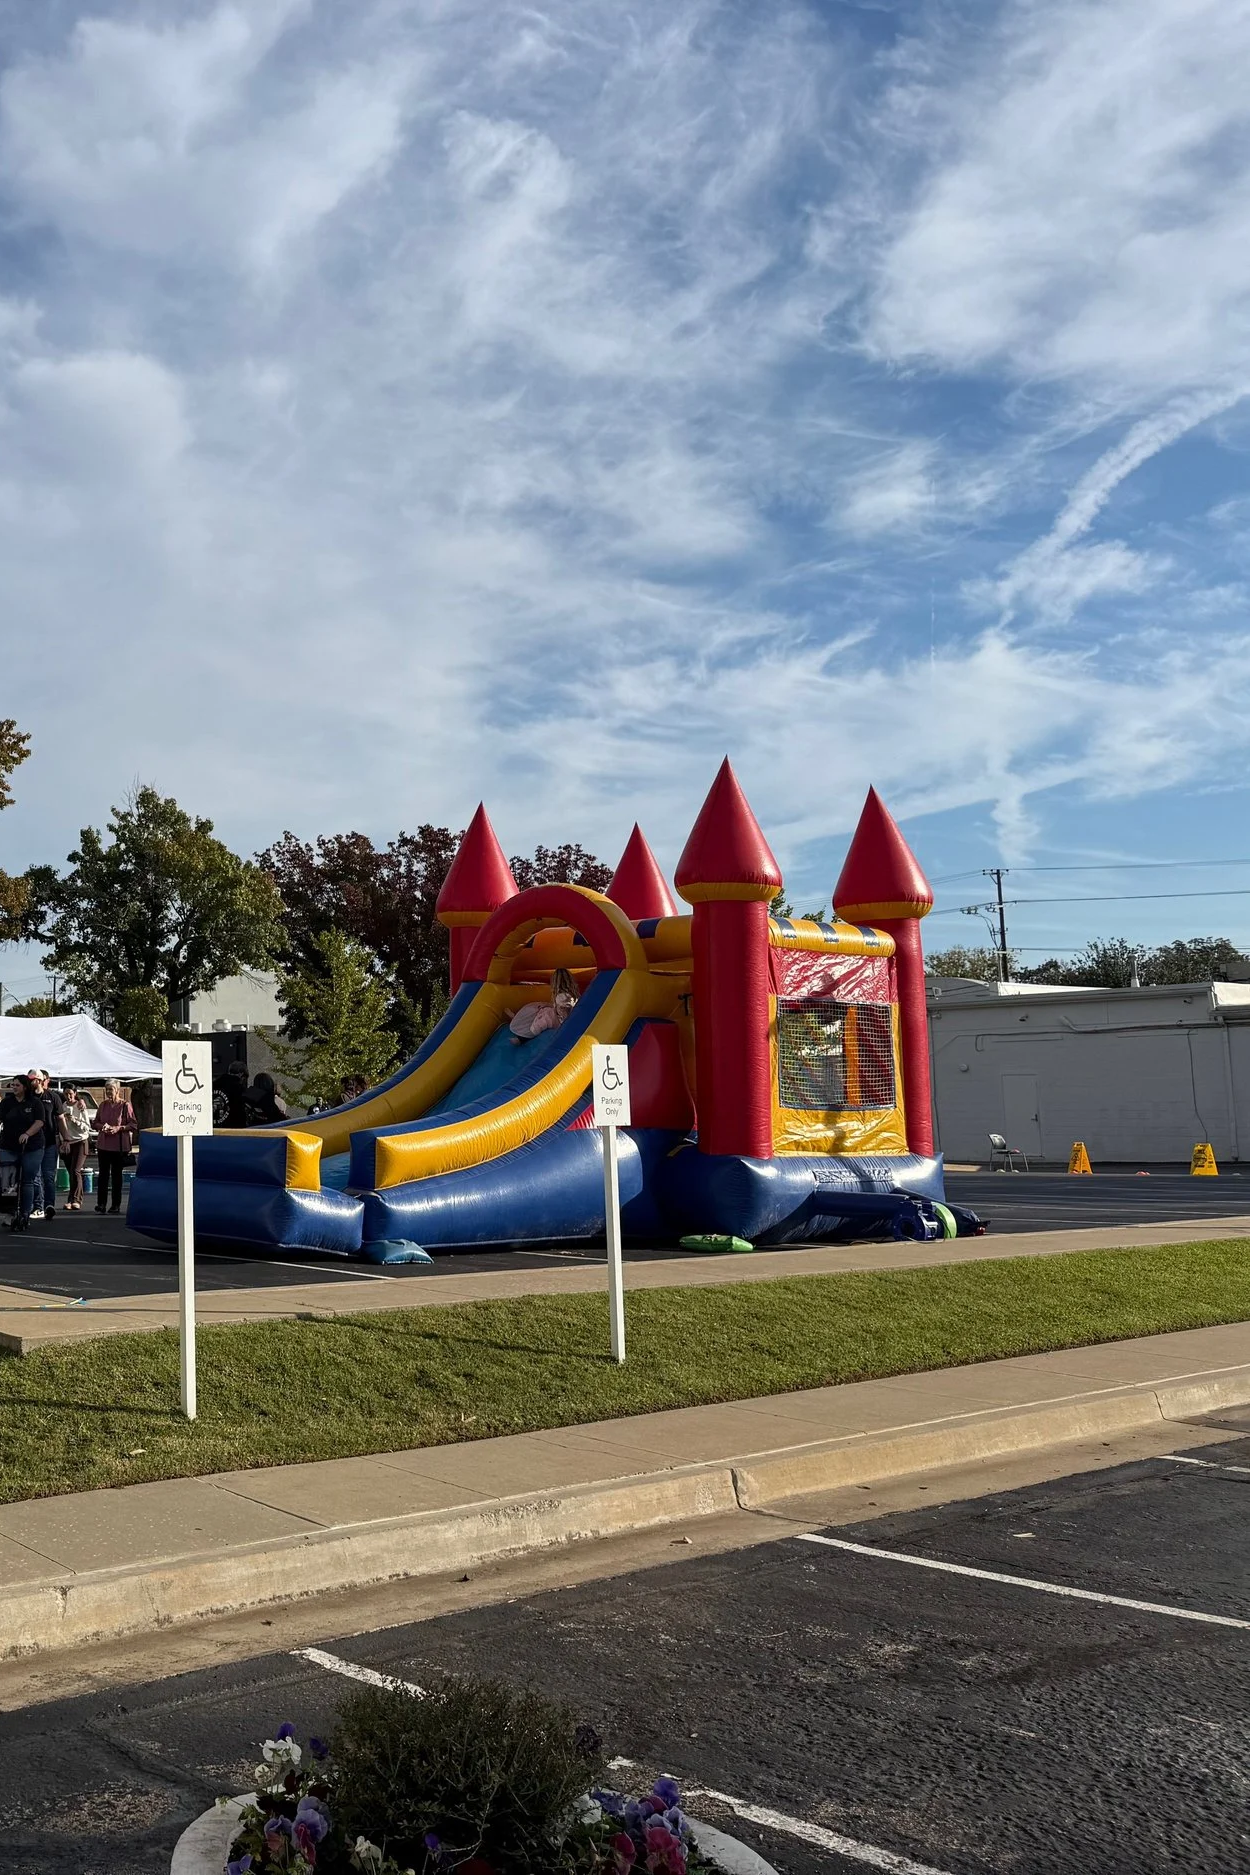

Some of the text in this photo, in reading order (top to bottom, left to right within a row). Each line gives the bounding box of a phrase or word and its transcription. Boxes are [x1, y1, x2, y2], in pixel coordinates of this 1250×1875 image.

[173, 1101, 202, 1112] Parking
[601, 1097, 622, 1106] Parking
[605, 1107, 619, 1117] Only
[178, 1114, 197, 1125] Only
